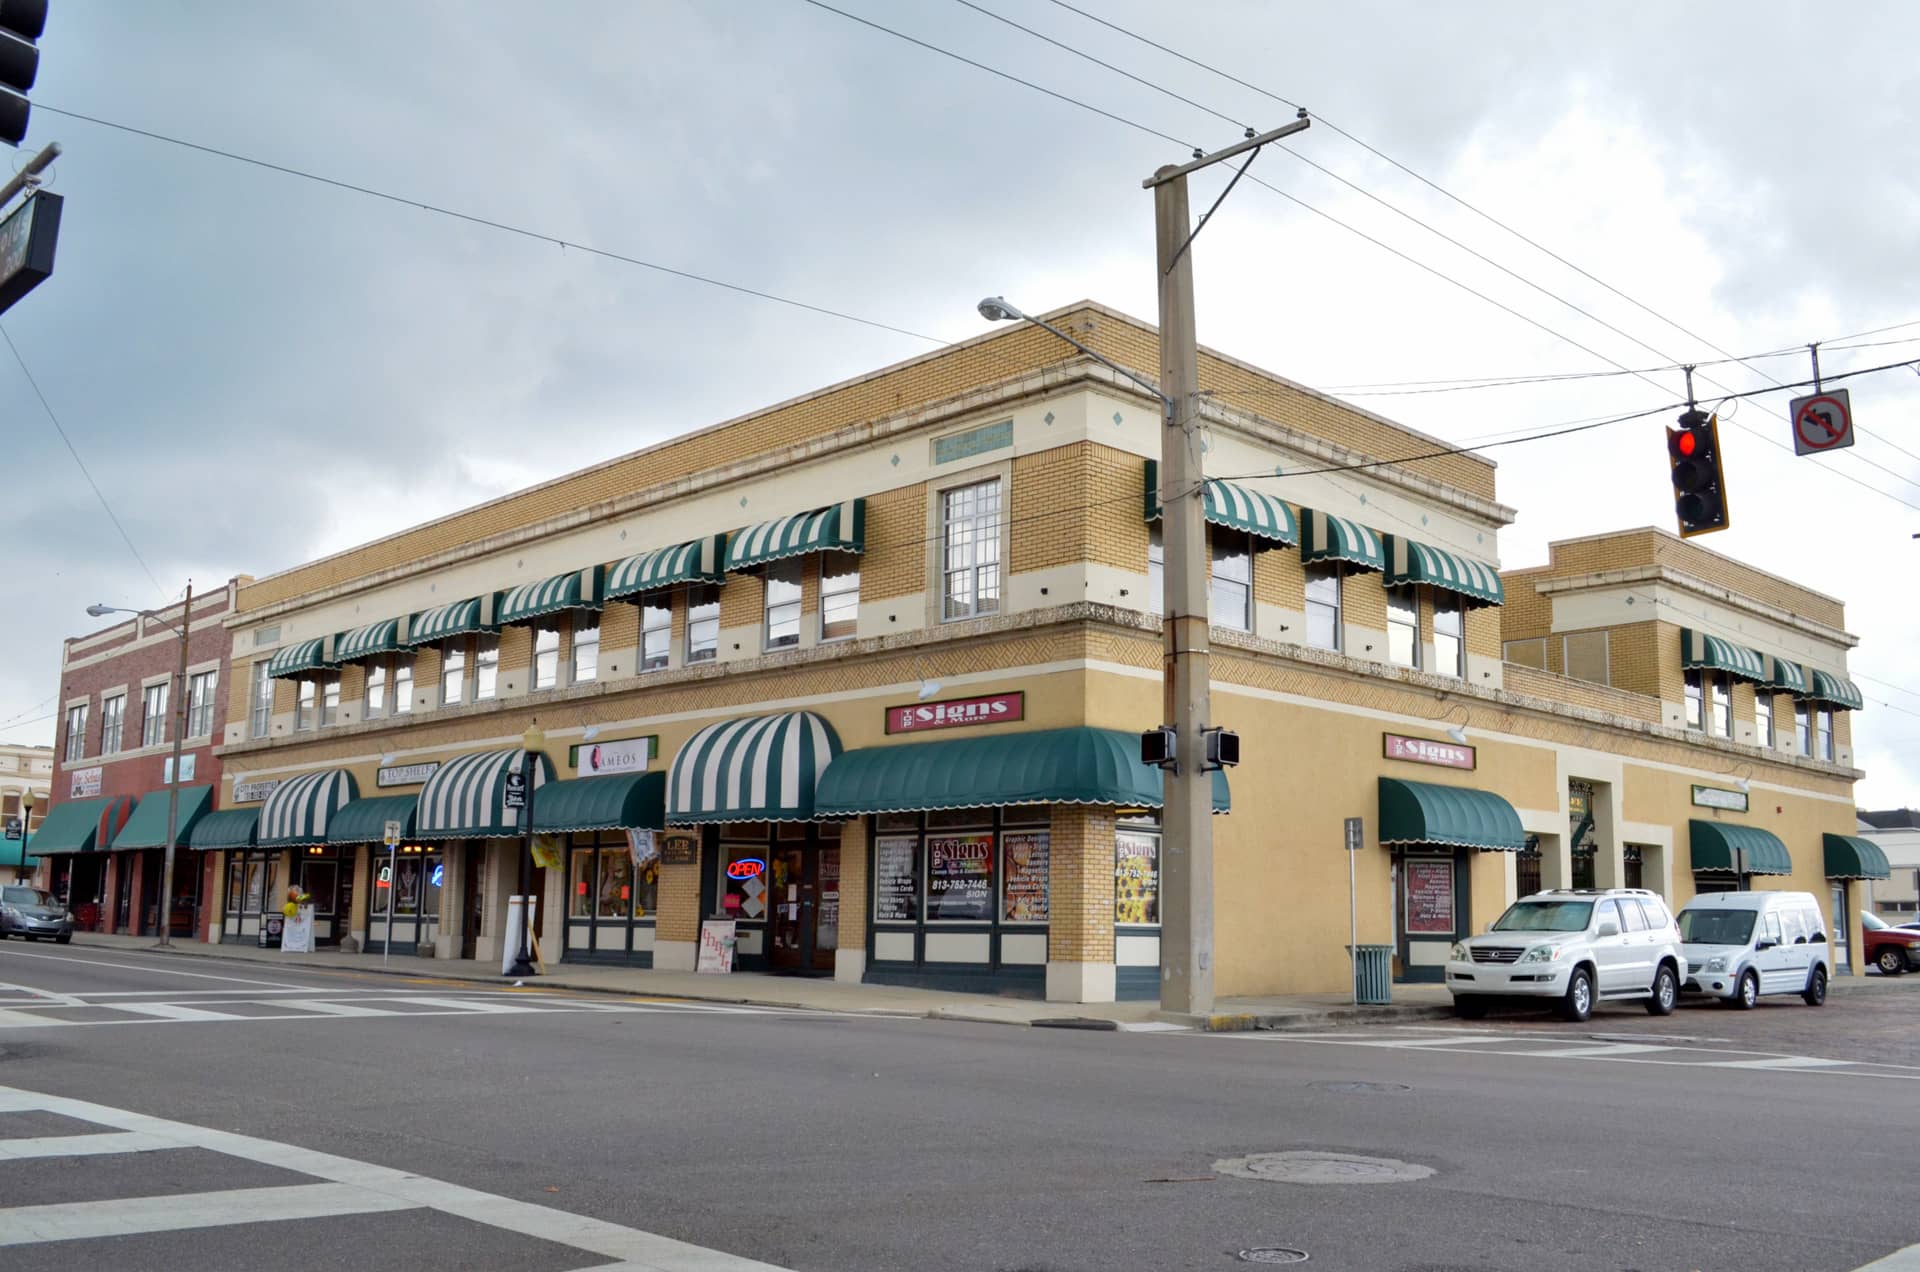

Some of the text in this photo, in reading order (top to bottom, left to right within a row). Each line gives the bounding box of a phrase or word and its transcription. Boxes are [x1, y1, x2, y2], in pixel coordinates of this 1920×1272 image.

[916, 700, 1008, 722] Signs
[950, 714, 988, 724] More
[1405, 740, 1465, 761] Signs
[942, 840, 989, 861] Signs
[1124, 842, 1156, 859] Signs
[727, 862, 762, 877] OPEN
